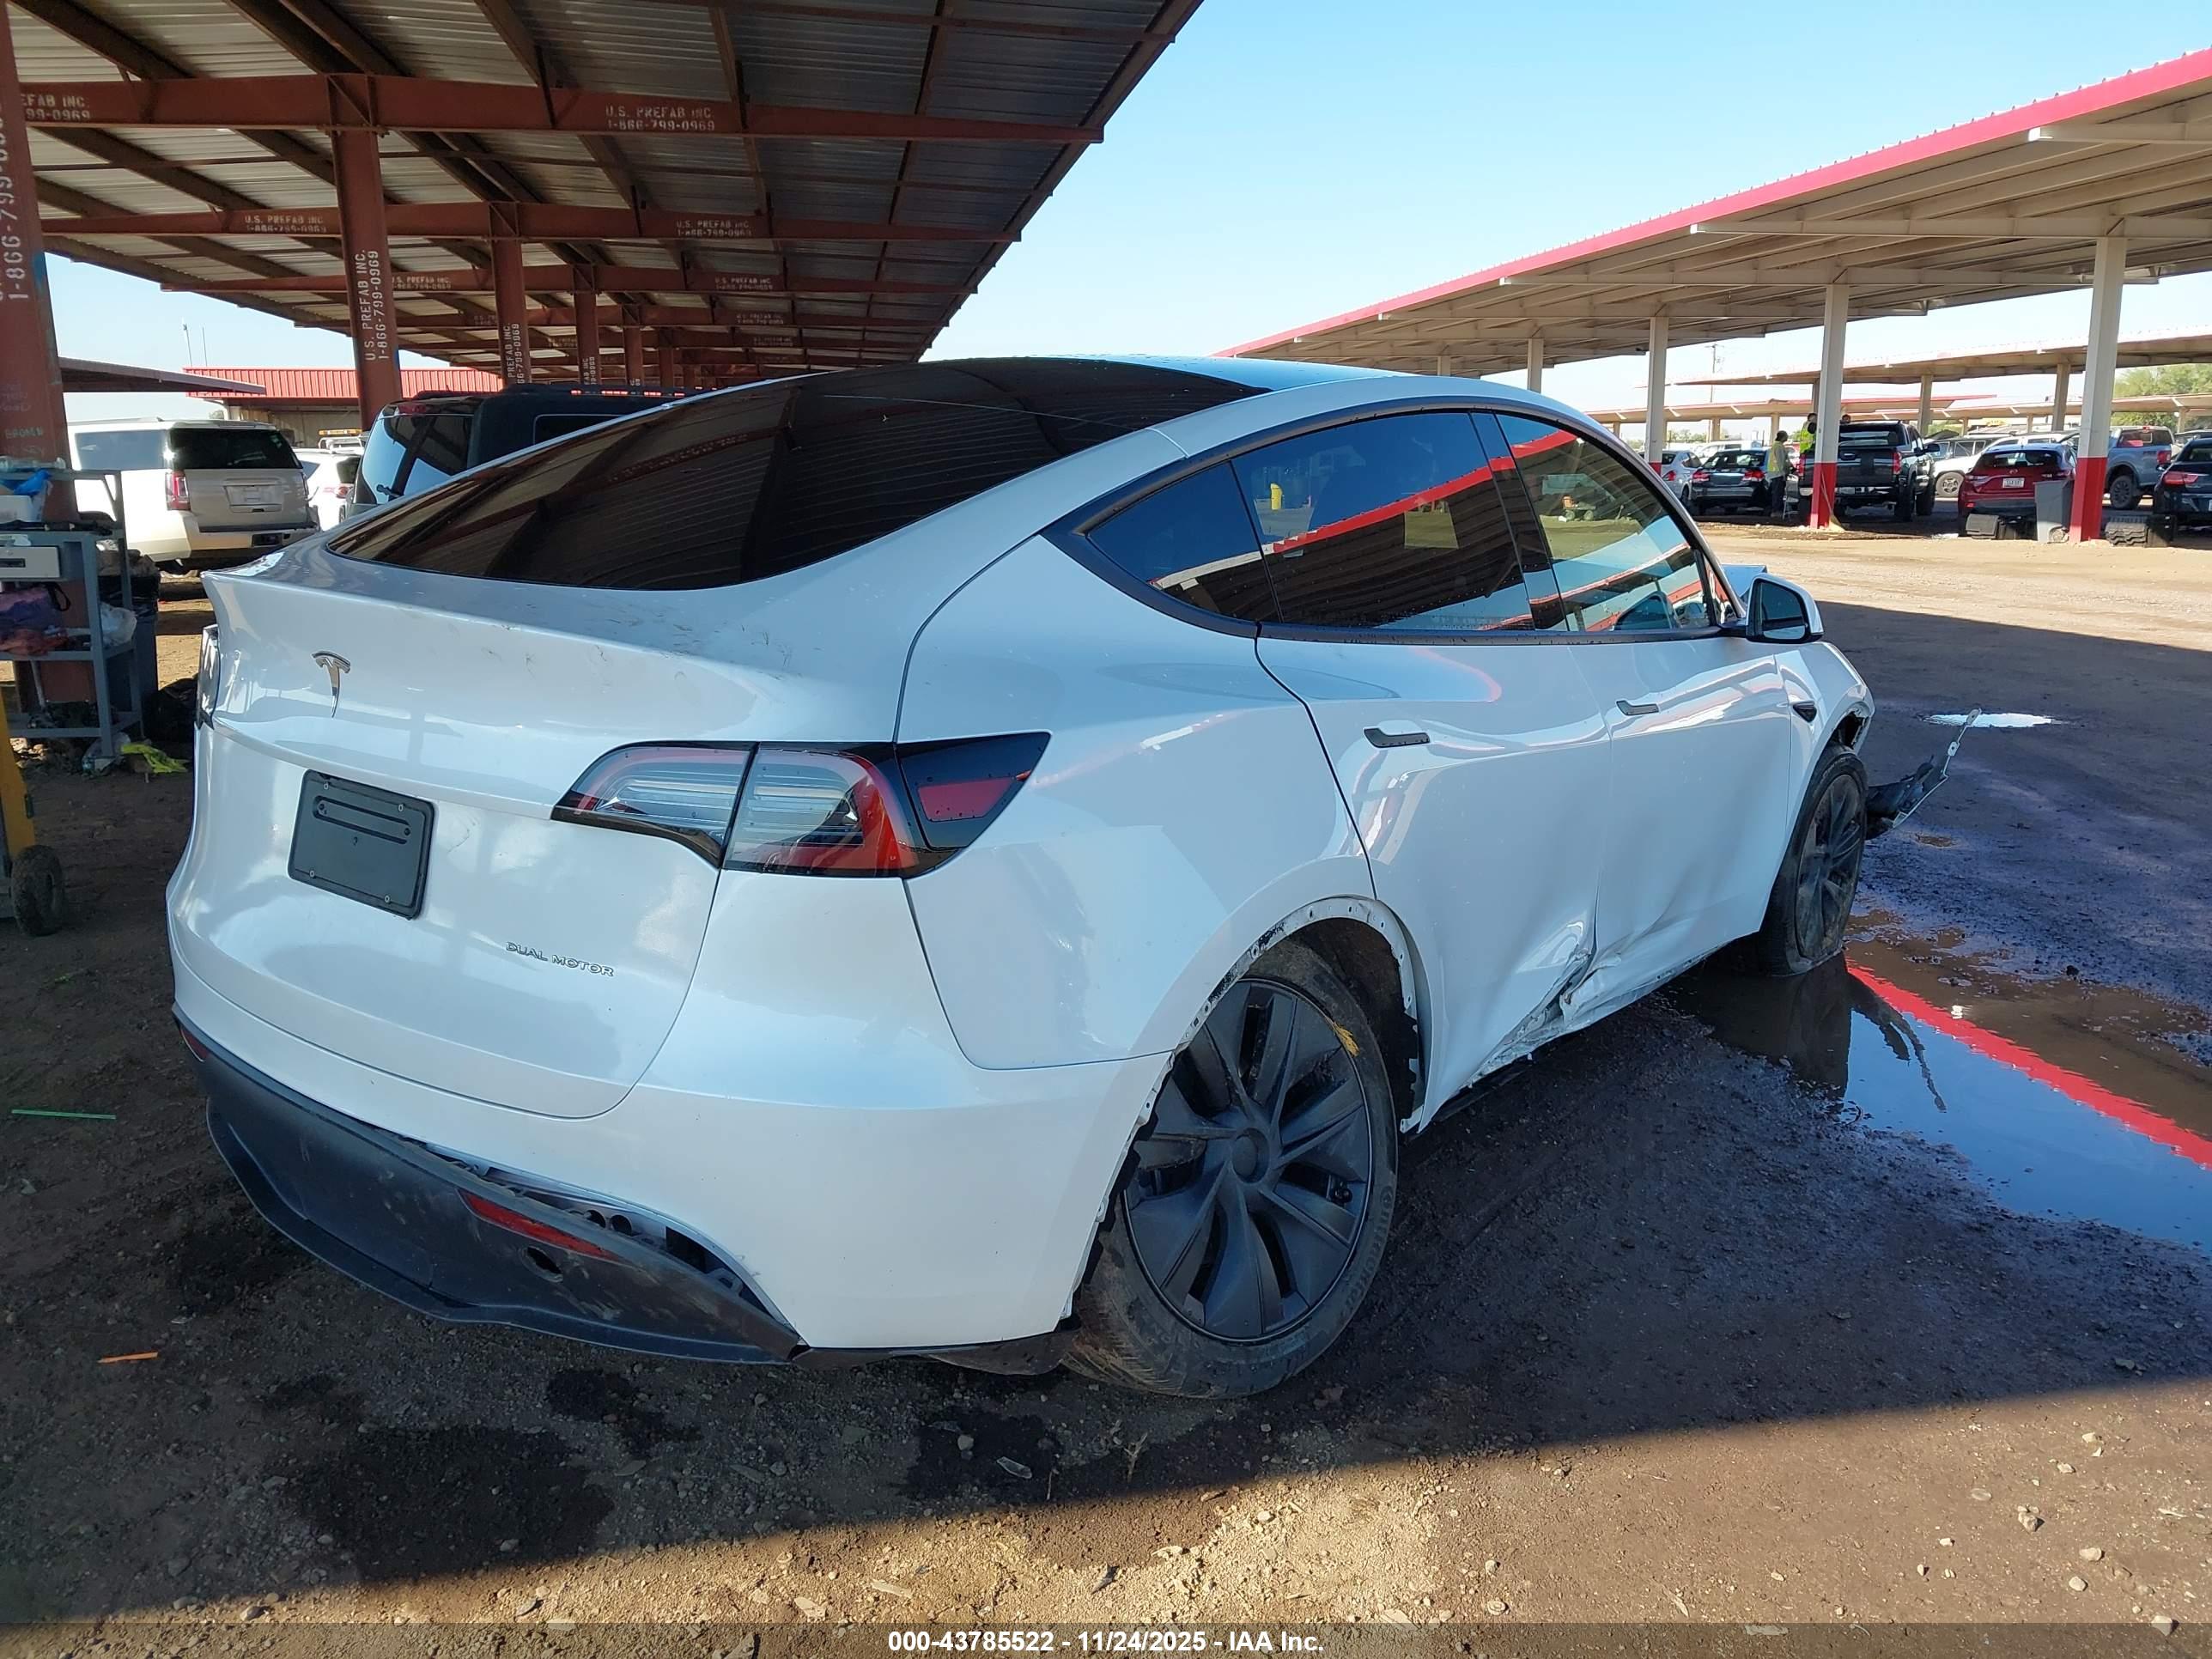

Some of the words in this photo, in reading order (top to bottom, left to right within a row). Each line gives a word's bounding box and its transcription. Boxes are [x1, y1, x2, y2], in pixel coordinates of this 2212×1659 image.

[636, 106, 686, 118] PREFAB
[267, 215, 305, 224] PREFAB
[697, 220, 732, 228] PREFAB
[355, 249, 368, 274] INC.
[357, 280, 373, 330] PREFAB
[368, 250, 390, 360] 1-866-799-0969
[504, 343, 516, 378] PREFAB
[506, 941, 549, 962] DUAL
[551, 954, 615, 977] MOTOR
